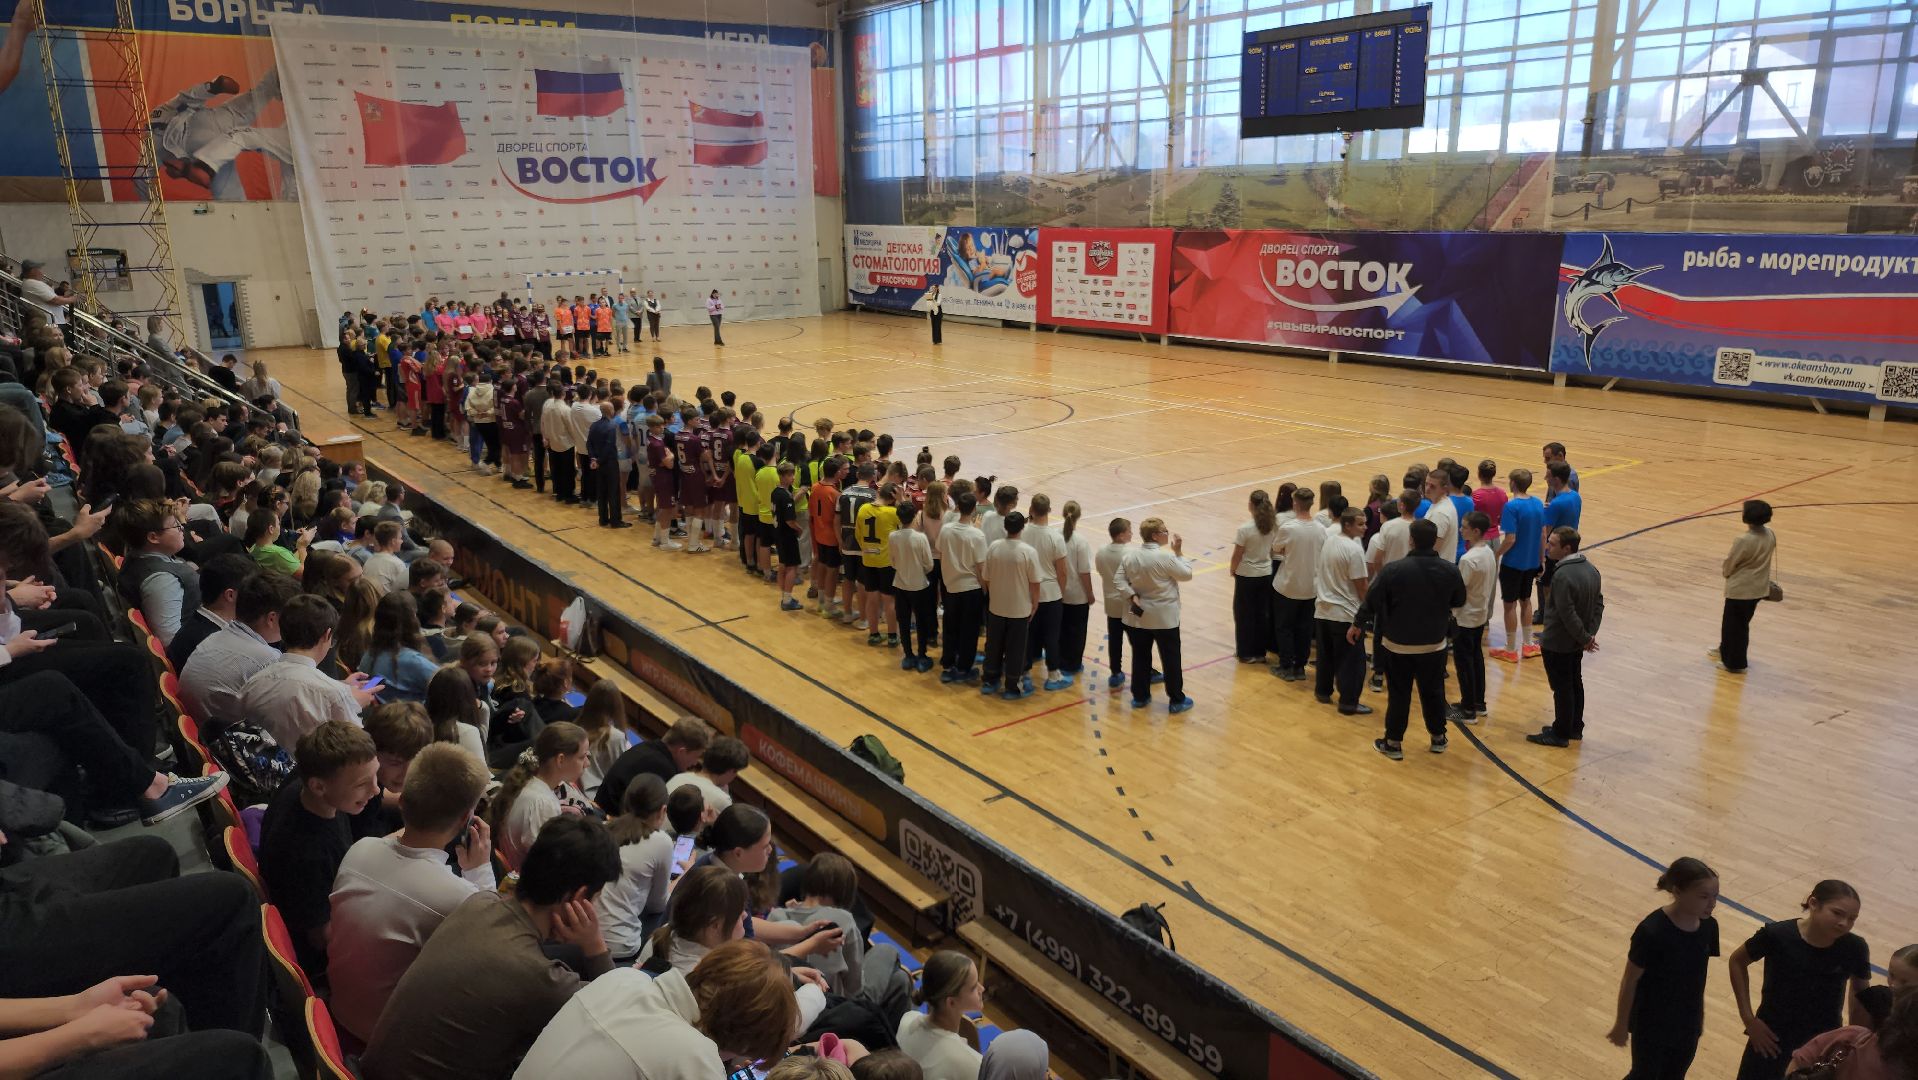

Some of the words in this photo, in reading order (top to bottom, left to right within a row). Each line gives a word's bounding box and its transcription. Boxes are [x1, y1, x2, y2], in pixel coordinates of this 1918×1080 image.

[497, 142, 543, 153] ДВОРЕЦ
[546, 142, 589, 152] СПОРТА
[516, 156, 657, 184] ВОСТОК
[887, 242, 923, 255] ДЕТСКАЯ
[1260, 244, 1299, 256] ДВОРЕЦ
[1301, 244, 1340, 256] СПОРТА
[1683, 246, 1741, 271] рыба
[852, 254, 939, 273] СТОМАТОЛОГИЯ
[882, 275, 918, 286] РАССРОЧКУ
[1276, 259, 1413, 293] ВОСТОК
[1267, 320, 1406, 340] #ЯВЫБИРАЮСПОРТ
[1764, 360, 1853, 376] www.okeanshop.ru
[1783, 373, 1867, 391] vk.com/okeanmag
[677, 443, 686, 464] 6
[713, 440, 722, 461] 8
[864, 516, 881, 544] 1
[759, 739, 861, 819] КОФЕМАШИНЫ
[995, 904, 1018, 931] +7
[1025, 920, 1082, 980] (499)
[1089, 964, 1223, 1074] 322-89-59
